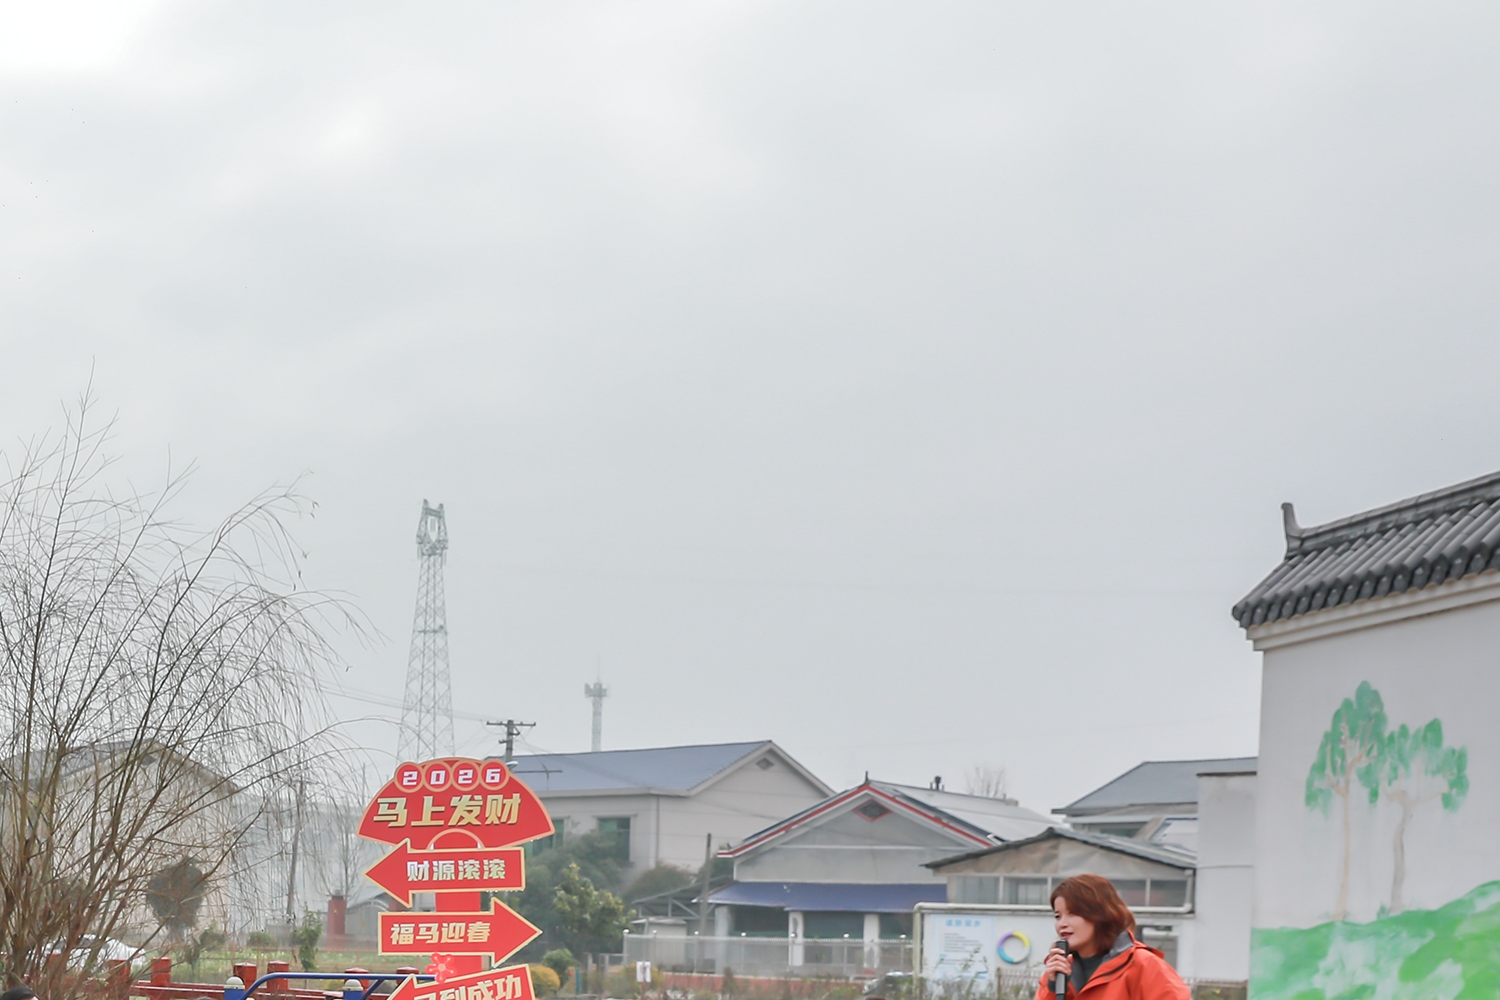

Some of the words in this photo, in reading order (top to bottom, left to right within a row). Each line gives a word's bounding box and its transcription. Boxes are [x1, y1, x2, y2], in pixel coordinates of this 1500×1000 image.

[402, 768, 502, 786] 2026
[373, 793, 521, 828] 马上发财
[407, 859, 506, 882] 财源滚滚
[390, 922, 491, 945] 福马迎春
